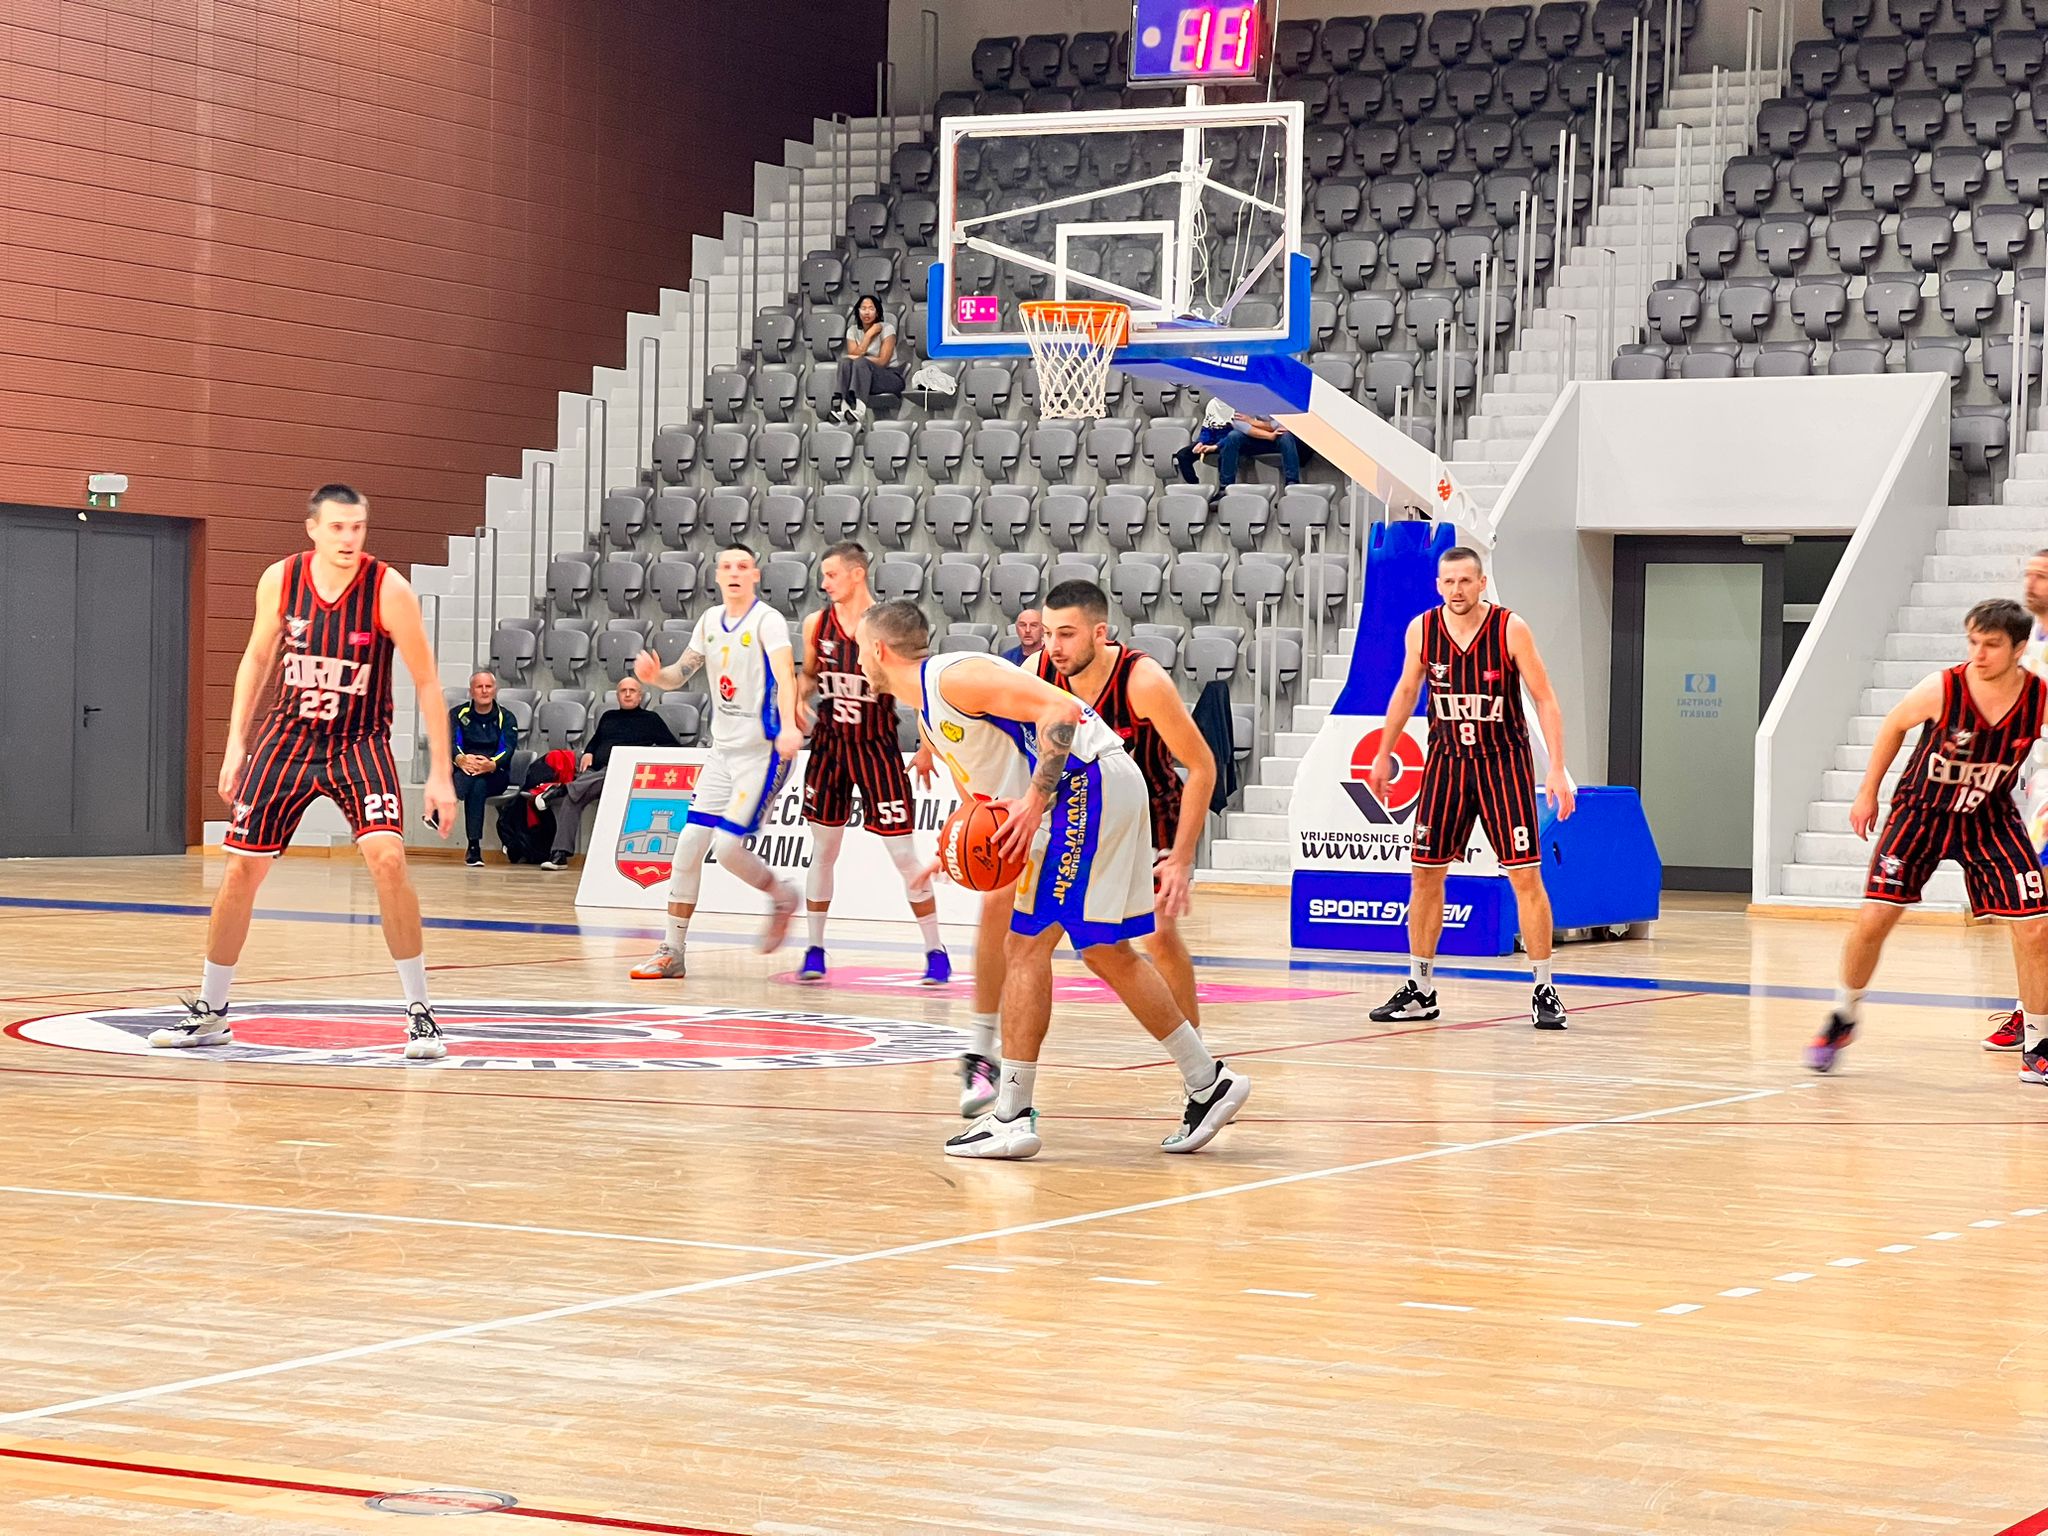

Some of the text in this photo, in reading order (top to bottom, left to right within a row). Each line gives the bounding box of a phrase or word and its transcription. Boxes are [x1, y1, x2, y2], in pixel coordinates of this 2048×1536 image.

[1195, 8, 1251, 69] 11
[299, 689, 340, 720] 23
[832, 697, 862, 724] 55
[1432, 692, 1504, 722] ORICA
[1459, 722, 1477, 746] 8
[1928, 752, 2018, 793] GORIC
[364, 794, 399, 820] 23
[877, 800, 908, 824] 55
[1953, 787, 1986, 814] 19
[1300, 831, 1399, 843] VRIJEDNOSNICE
[1512, 825, 1530, 851] 8
[1302, 842, 1482, 864] www.vrr
[2015, 870, 2044, 900] 19
[1309, 899, 1473, 923] SPORTSYEM
